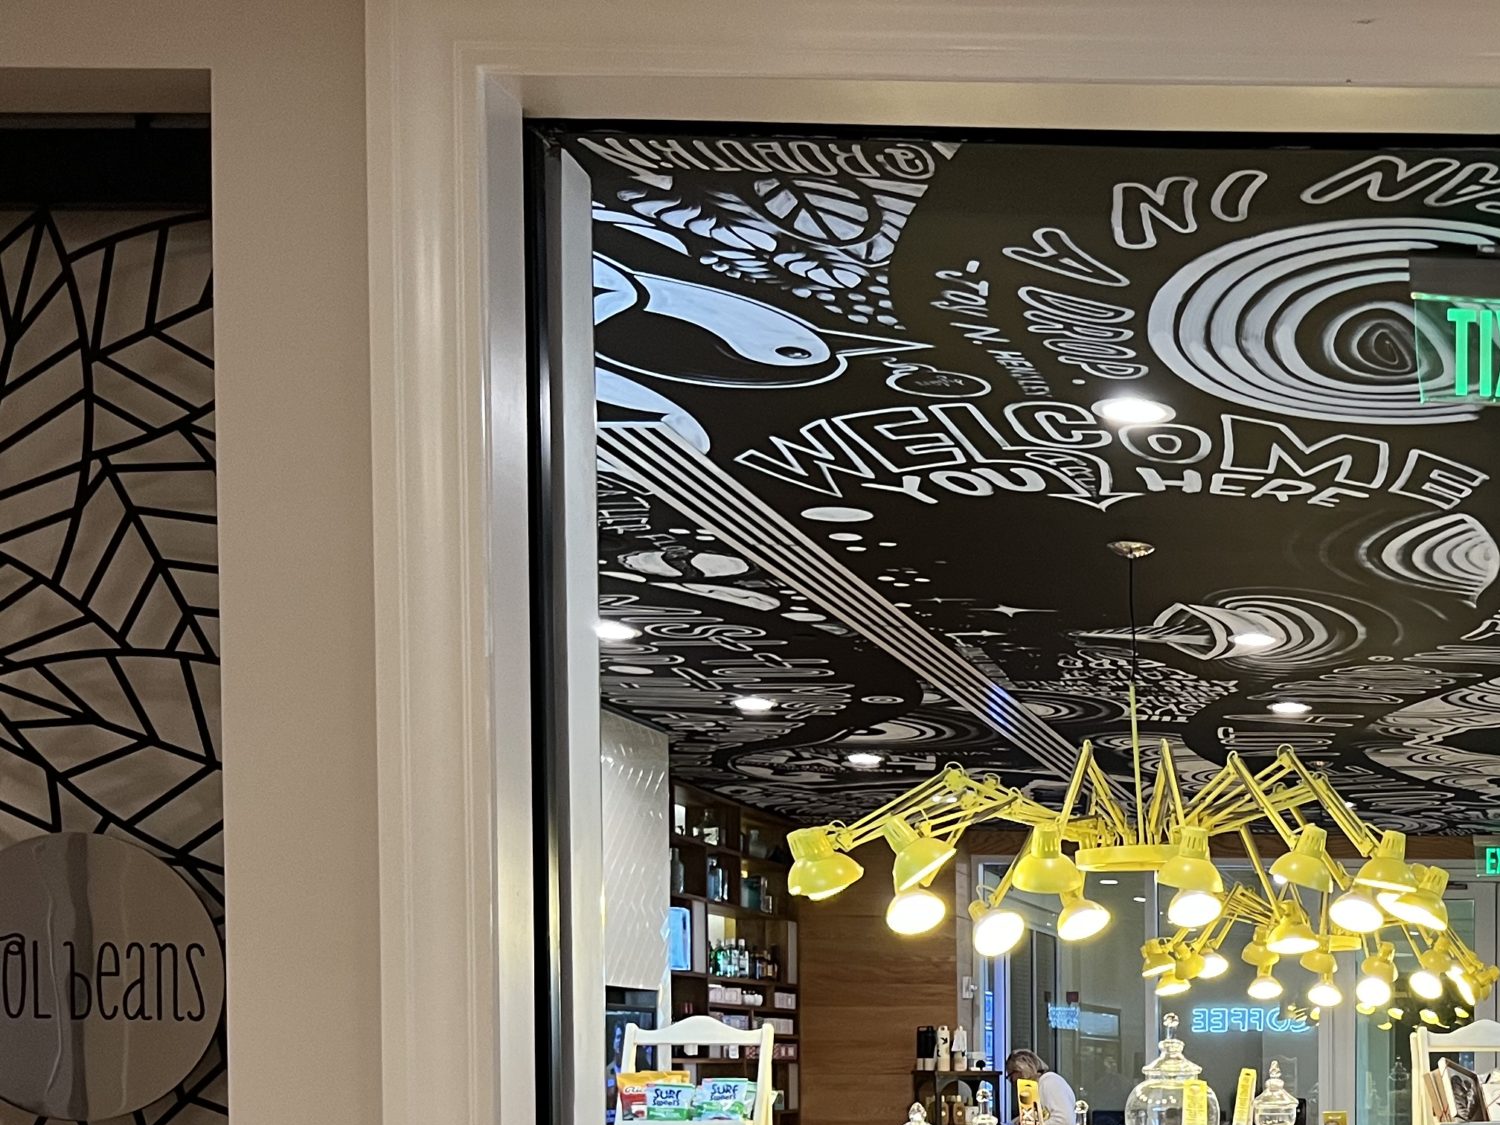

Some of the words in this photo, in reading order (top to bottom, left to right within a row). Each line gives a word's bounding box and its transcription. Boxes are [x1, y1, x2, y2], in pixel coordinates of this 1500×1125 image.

[735, 400, 1490, 510] WELCOME
[1137, 466, 1370, 508] HERE
[0, 933, 52, 1020] OL
